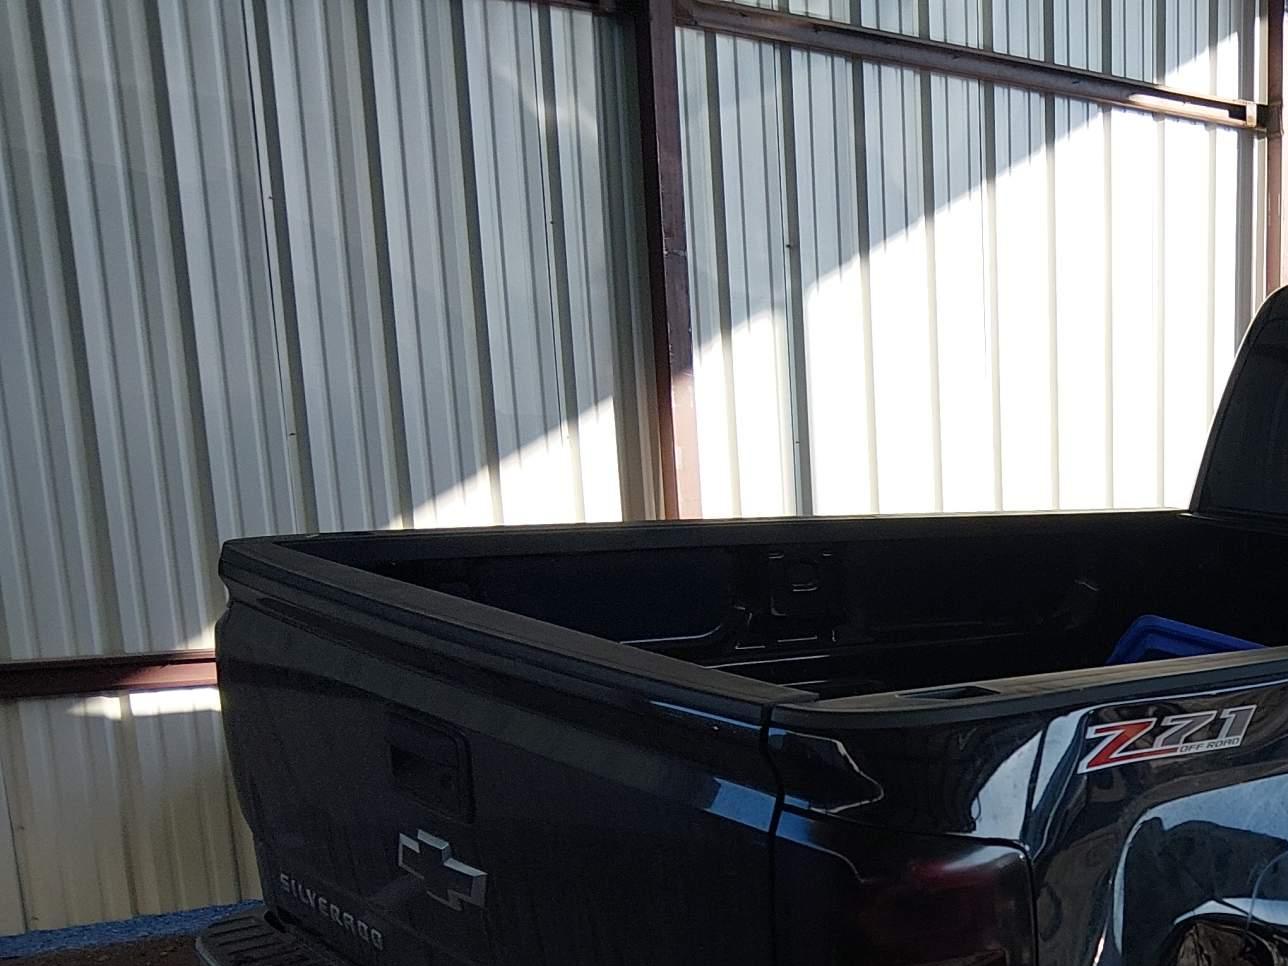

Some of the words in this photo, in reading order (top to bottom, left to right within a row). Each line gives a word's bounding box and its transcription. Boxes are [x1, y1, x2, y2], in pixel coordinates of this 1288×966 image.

[1077, 704, 1257, 774] Z71
[1179, 743, 1204, 753] OFF
[1206, 737, 1241, 749] ROAD
[280, 872, 384, 951] SILVERADO
